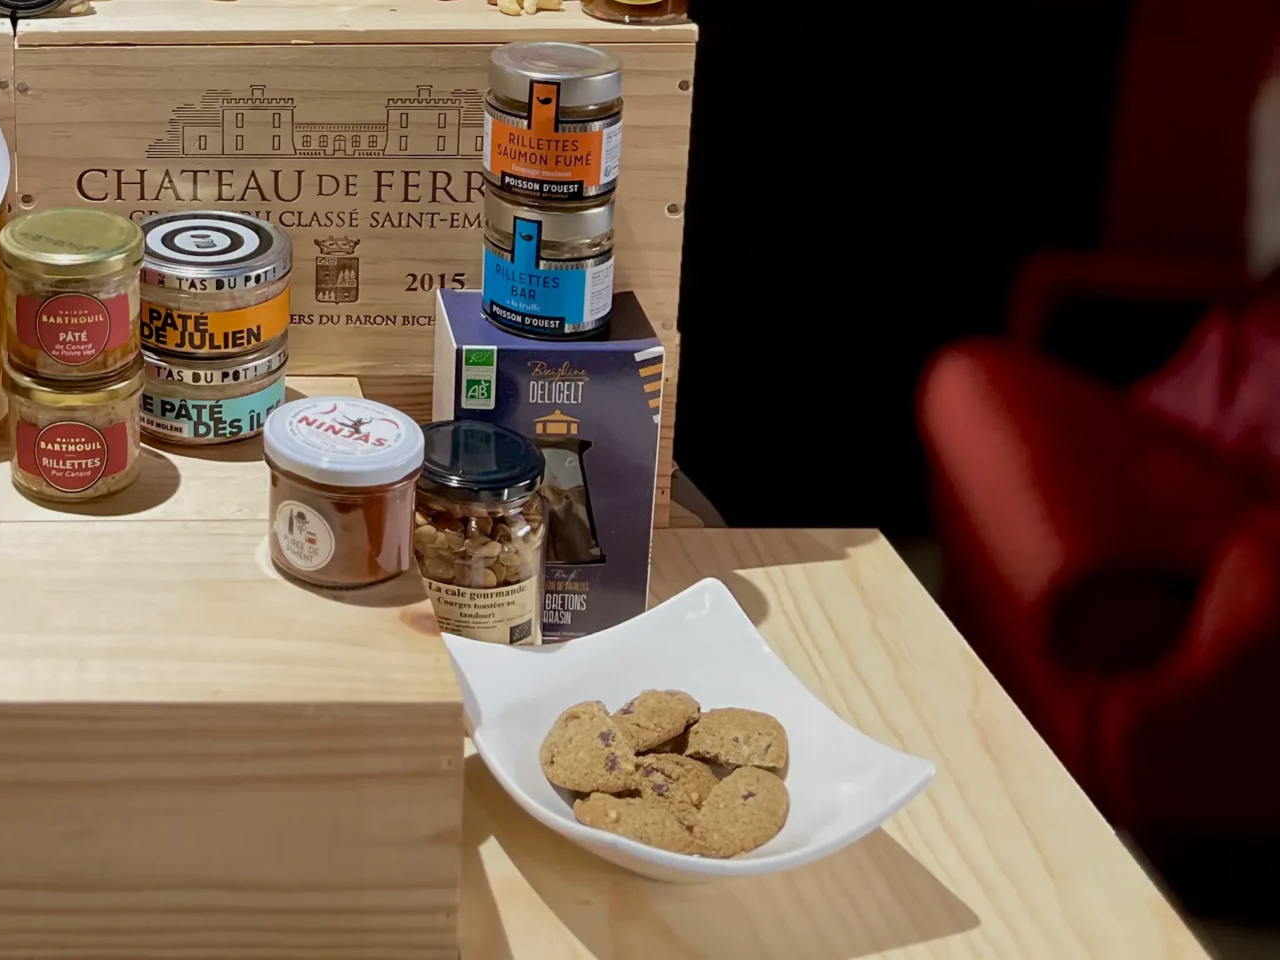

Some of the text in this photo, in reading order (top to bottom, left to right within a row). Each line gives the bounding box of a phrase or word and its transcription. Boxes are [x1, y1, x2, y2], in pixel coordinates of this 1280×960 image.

[508, 132, 579, 152] RILLETTES
[497, 143, 592, 168] SAUMON FUMÉ
[541, 169, 572, 178] maison
[76, 169, 305, 203] CHATEAU
[317, 173, 358, 197] DE
[504, 175, 579, 193] POISSON D'OUEST
[279, 209, 360, 228] CLASSÉ
[176, 277, 237, 291] T'AS DU
[404, 273, 466, 292] 2015
[495, 263, 560, 289] RILLETTES
[511, 285, 536, 301] BAR
[519, 301, 541, 312] truffe
[42, 314, 104, 324] BARTHOUIL
[149, 308, 209, 333] PÂTÉ
[320, 315, 339, 326] DU
[345, 315, 397, 327] BARON
[492, 304, 522, 323] POISSON
[524, 315, 560, 329] D'OUEST
[59, 330, 88, 342] PÂTÉ
[140, 322, 263, 350] DE JULIEN
[66, 343, 93, 351] Canard
[155, 365, 214, 384] T'AS DU
[467, 384, 489, 399] AB
[529, 381, 585, 404] DELICELT
[160, 399, 223, 422] PÂTÉ
[146, 418, 184, 434] DE MOLÈNE
[193, 418, 244, 438] DES
[297, 416, 388, 447] NINJAS
[40, 441, 102, 452] BARTHOUIL
[42, 457, 101, 469] RILLETTES
[51, 469, 63, 477] Pur
[284, 533, 320, 556] PURÉE DE
[286, 543, 314, 563] PIMENT
[428, 581, 526, 600] La cale gourmande
[437, 596, 471, 609] Courges
[473, 601, 505, 609] toastées
[545, 593, 587, 611] BRETONS
